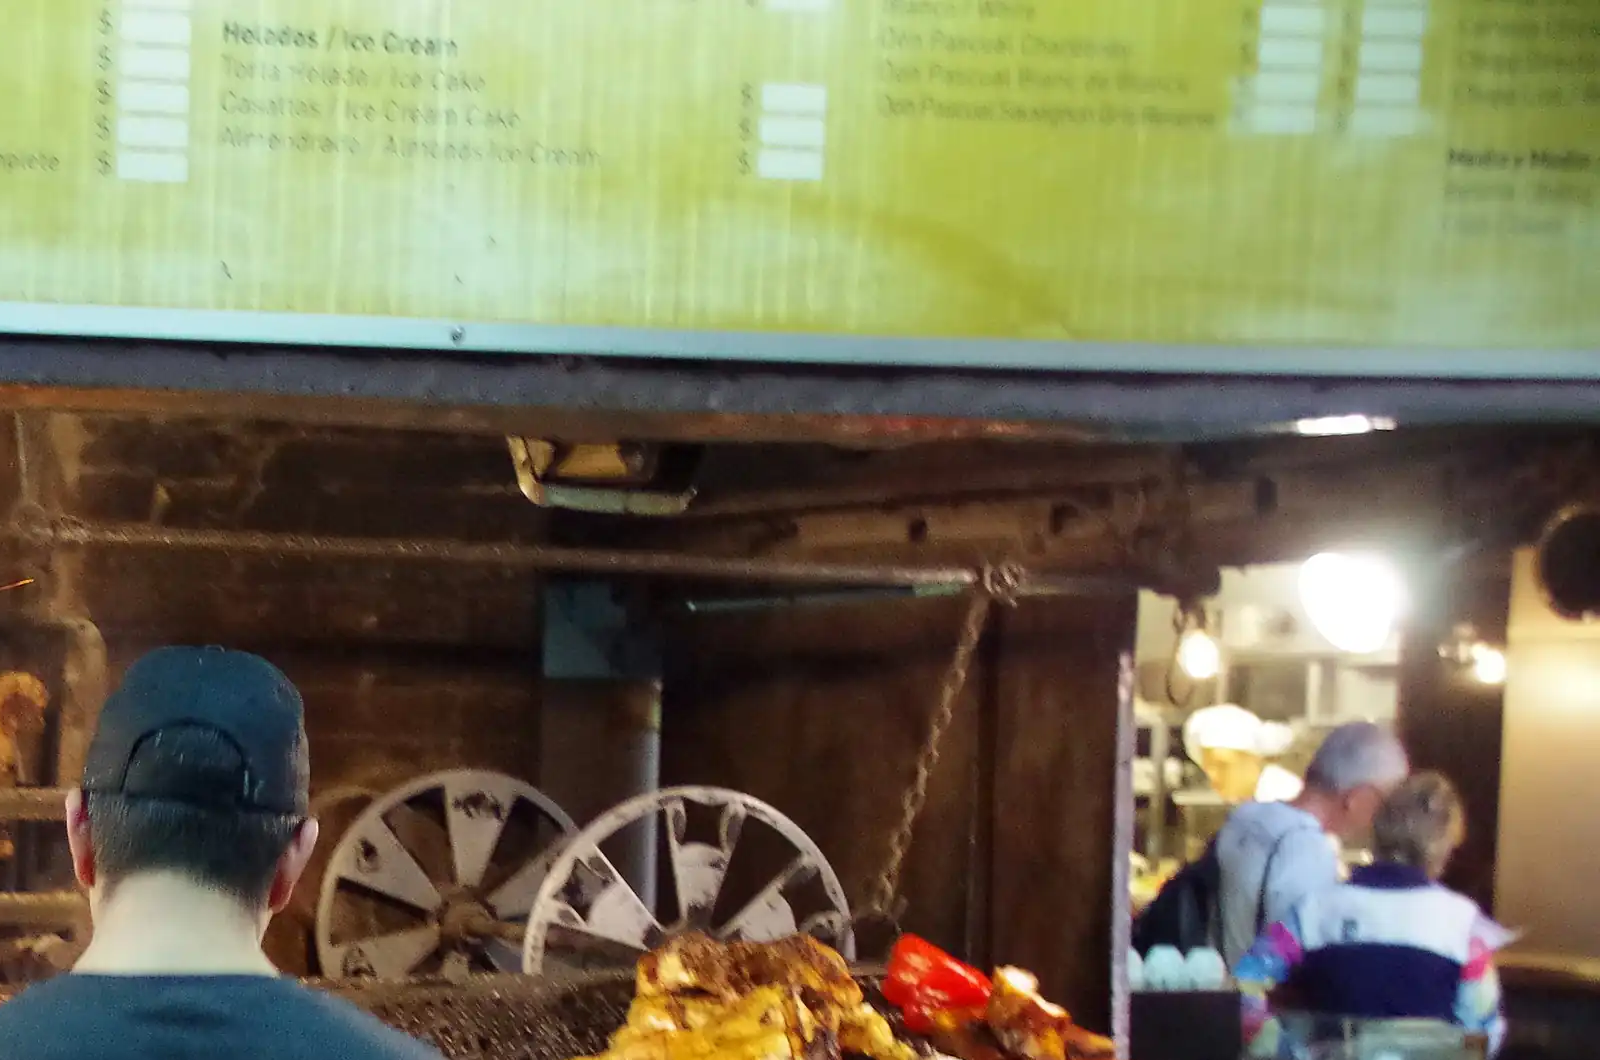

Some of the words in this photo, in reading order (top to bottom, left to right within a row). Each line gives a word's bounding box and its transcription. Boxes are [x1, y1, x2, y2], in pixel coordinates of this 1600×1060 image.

[222, 21, 318, 49] Helados
[342, 30, 375, 53] Ice
[382, 30, 458, 57] Cream
[390, 66, 423, 90] Ice
[431, 69, 486, 93] Cake
[345, 98, 376, 123] Ice
[382, 100, 458, 126] Cream
